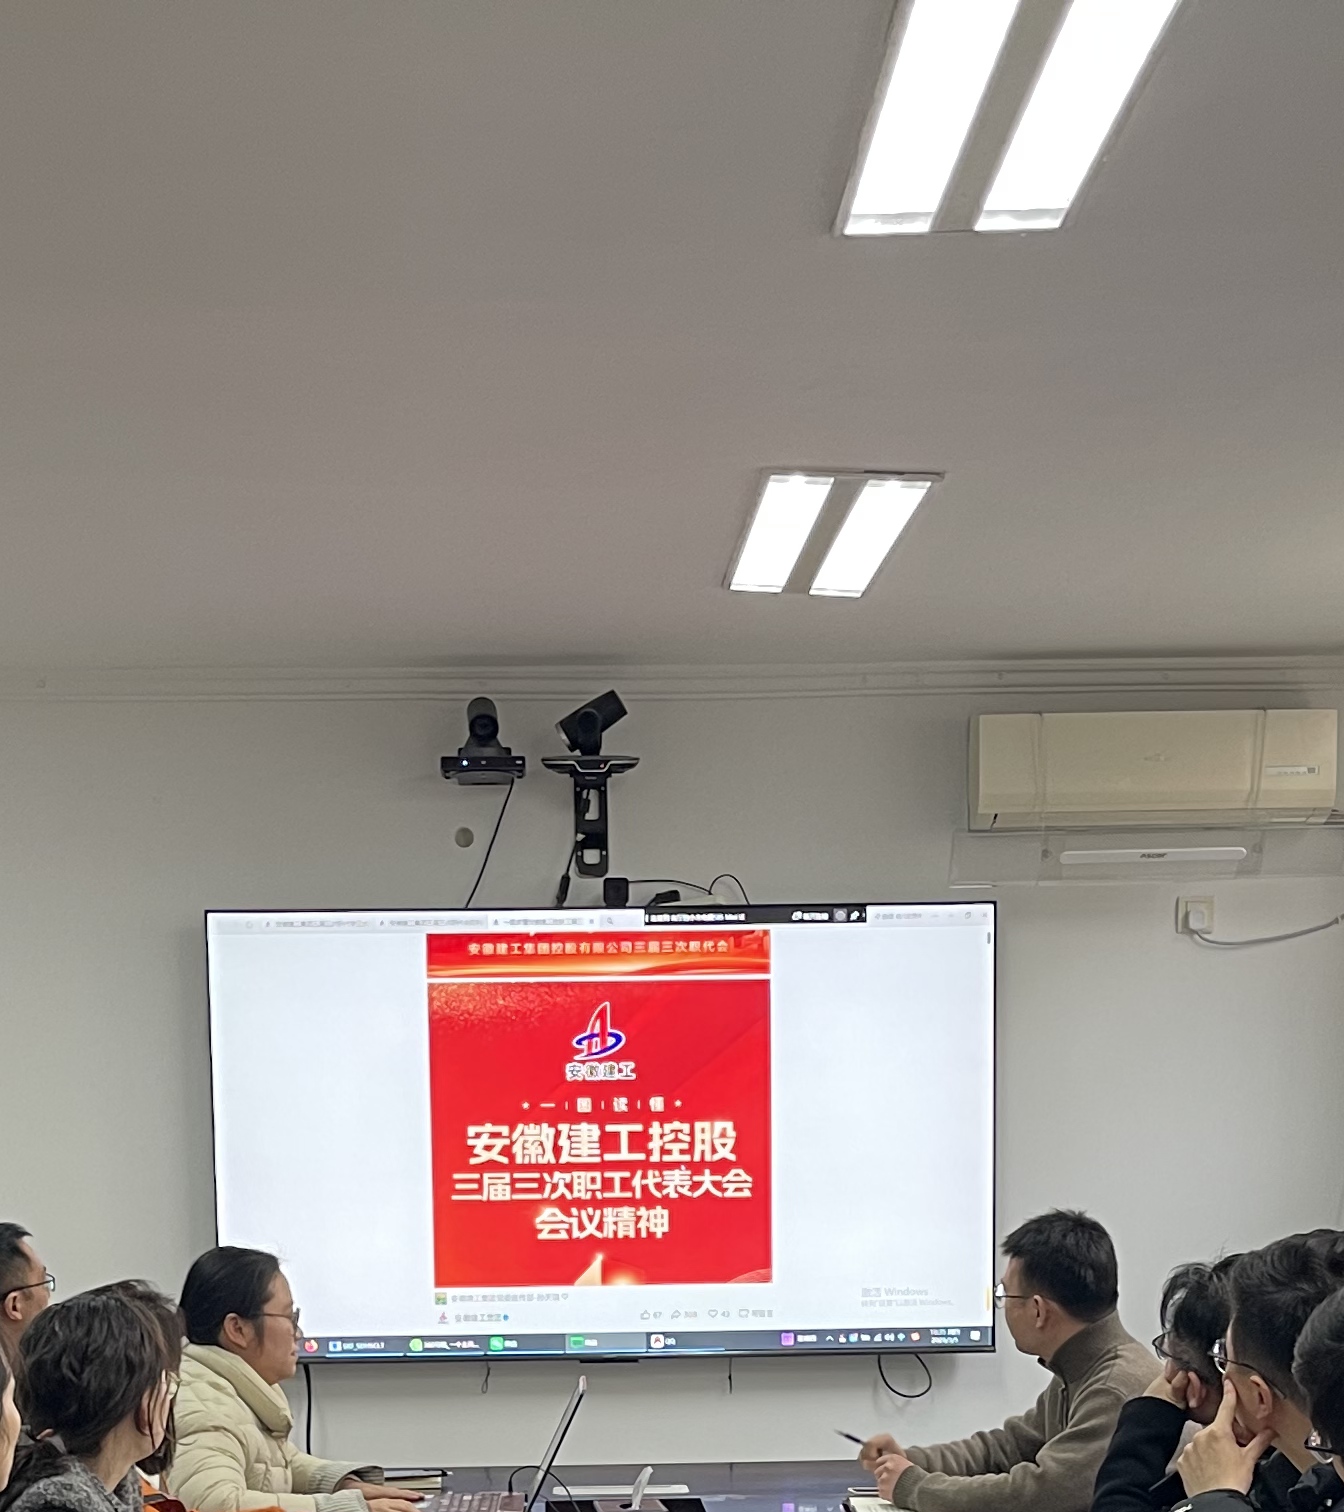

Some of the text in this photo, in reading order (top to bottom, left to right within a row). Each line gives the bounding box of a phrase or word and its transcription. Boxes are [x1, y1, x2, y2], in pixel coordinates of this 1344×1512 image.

[468, 940, 730, 955] 安徽建工集团控股有限公司三届三次职代会
[566, 1062, 636, 1081] 安徽建工
[467, 1121, 737, 1165] 安徽建工控股
[451, 1166, 753, 1201] 三届三次职工代表大会
[535, 1206, 669, 1240] 会议精神
[884, 1287, 929, 1297] Windows
